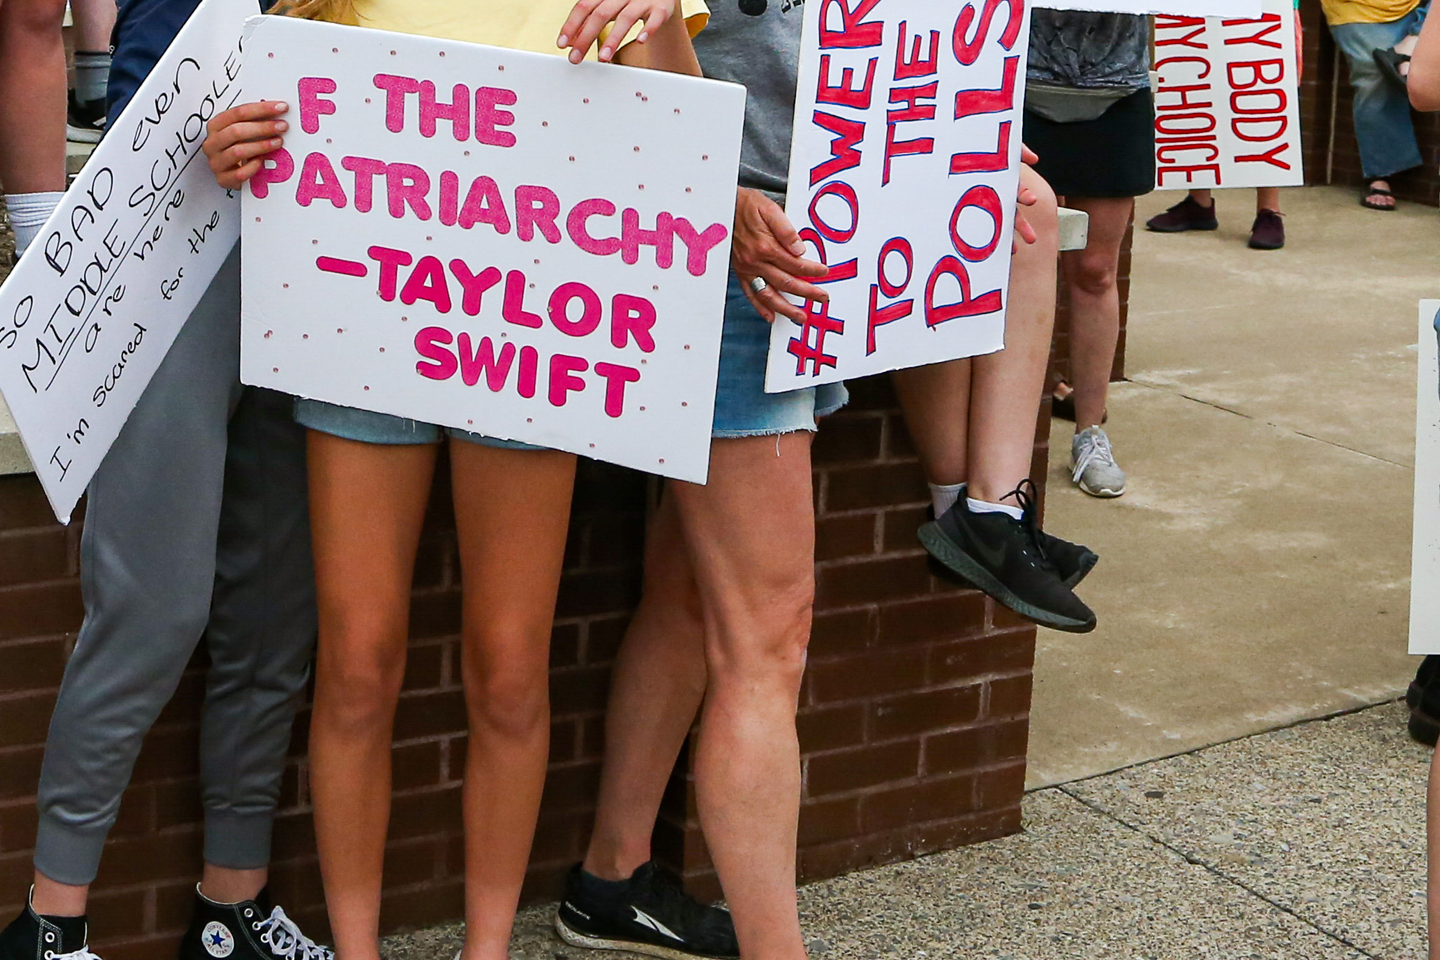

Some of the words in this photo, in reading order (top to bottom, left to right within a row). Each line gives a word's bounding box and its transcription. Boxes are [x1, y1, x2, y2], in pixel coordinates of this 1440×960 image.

[44, 167, 114, 277] BAD
[132, 57, 201, 153] even
[297, 77, 337, 134] F
[373, 73, 517, 148] THE
[882, 21, 940, 187] THE
[1155, 56, 1221, 187] CHOICE
[1226, 58, 1291, 170] BODY
[250, 148, 728, 277] PATRIARCHY
[21, 219, 126, 393] MIDDLE
[50, 418, 90, 482] I'm
[93, 323, 147, 407] scared
[160, 267, 185, 301] for
[188, 211, 220, 254] the
[85, 284, 126, 353] are
[866, 237, 914, 357] TO
[414, 326, 641, 419] SWIFT
